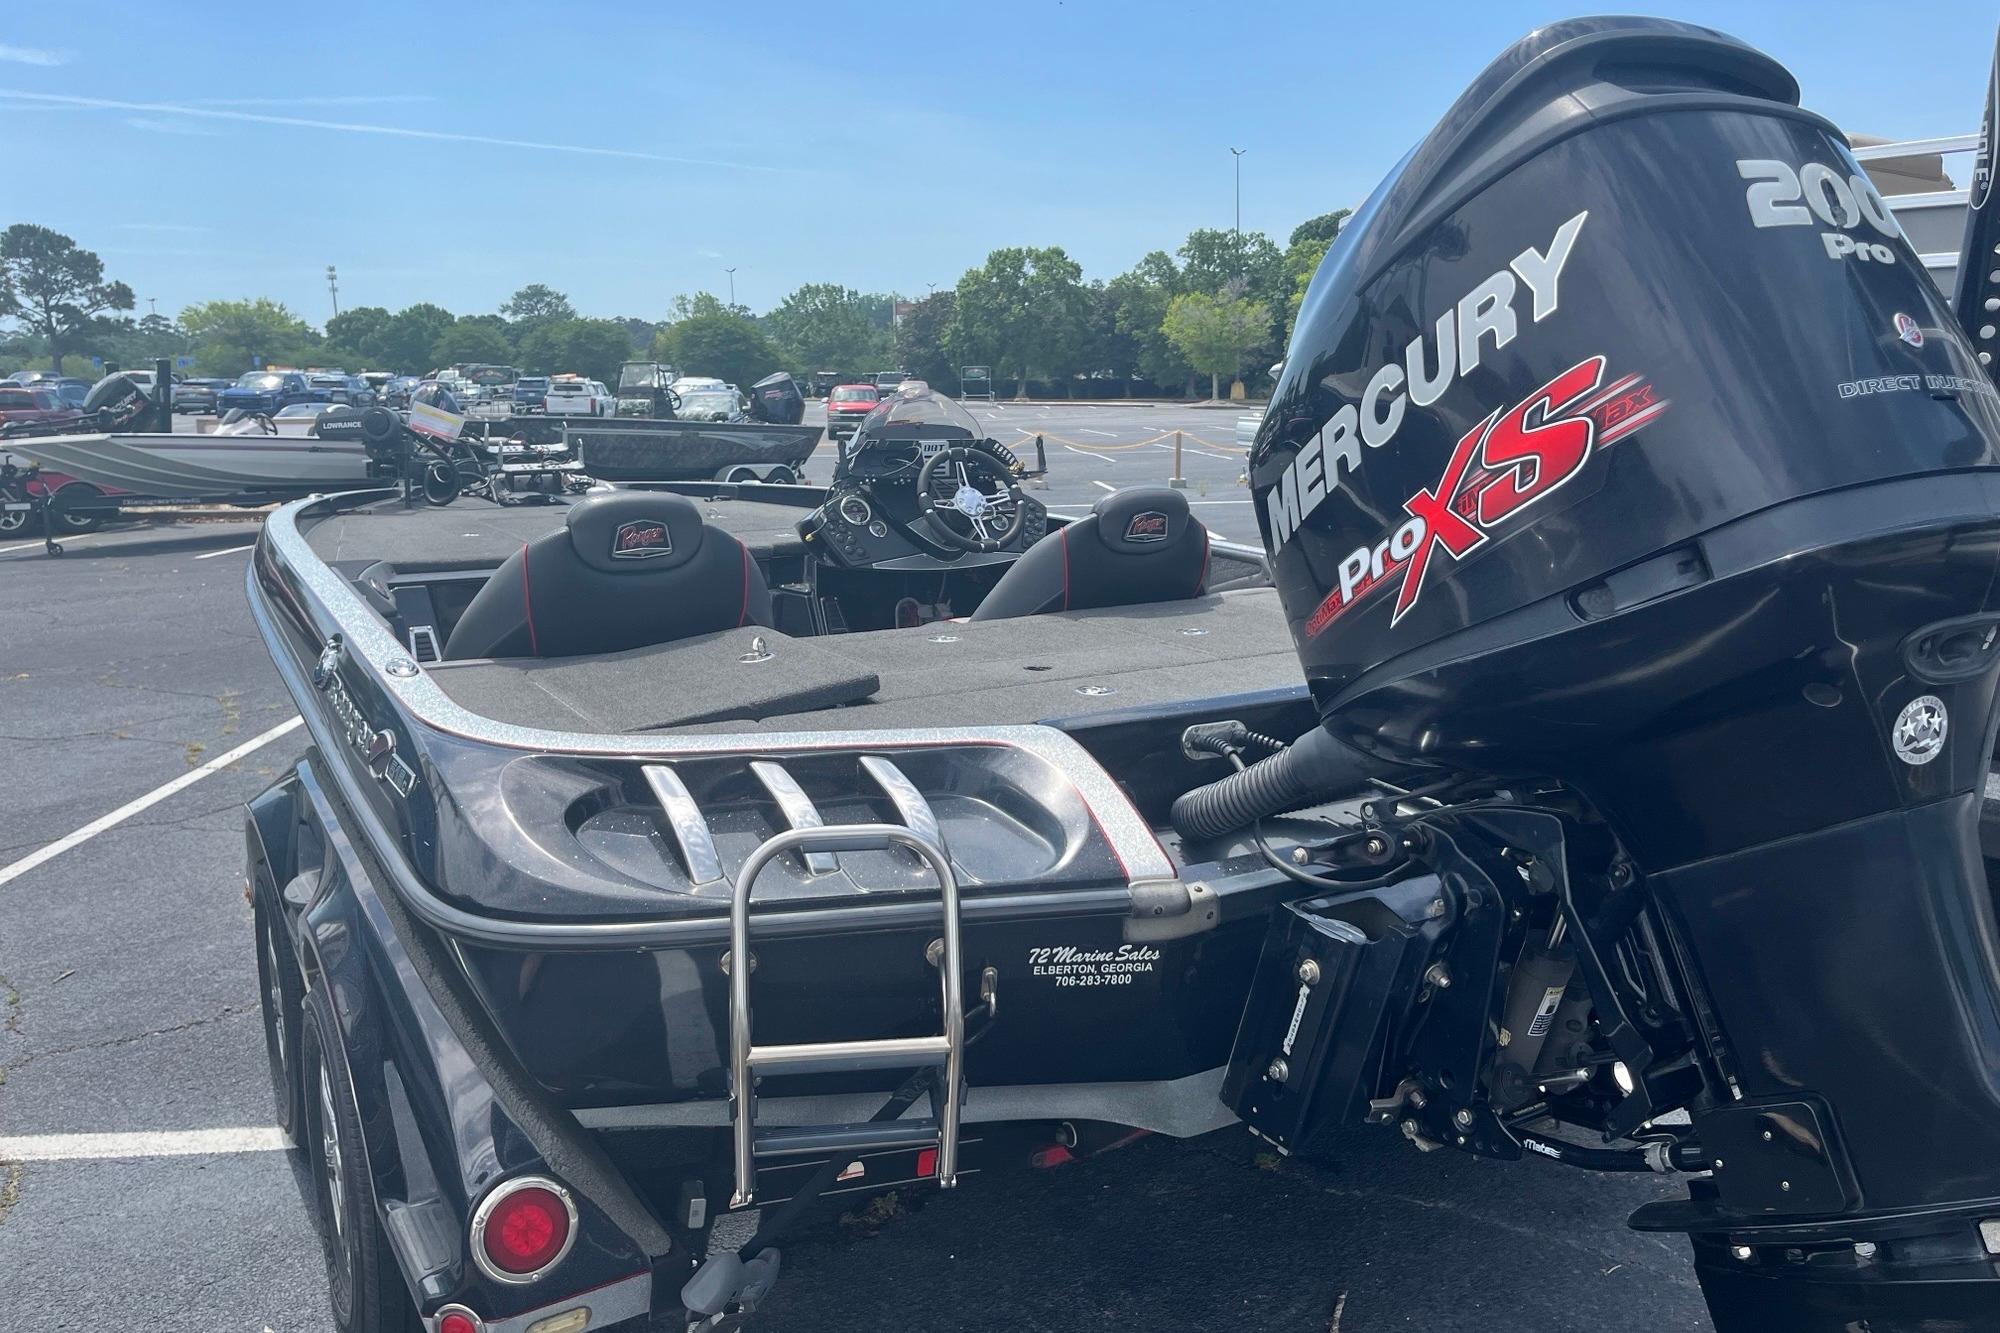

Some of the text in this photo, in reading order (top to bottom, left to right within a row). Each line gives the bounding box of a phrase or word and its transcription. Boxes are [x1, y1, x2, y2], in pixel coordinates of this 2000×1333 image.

[1736, 159, 1901, 239] 200
[1821, 233, 1896, 264] Pro
[1266, 210, 1589, 556] MERCURY
[1838, 374, 1921, 398] DIRECT
[322, 421, 362, 430] LOWRANCE
[620, 525, 663, 549] Ranger
[1029, 944, 1160, 964] 72 Marine Sales
[1033, 963, 1153, 976] ELBERTON, GEORGIA
[1055, 974, 1132, 987] 706-283-7800
